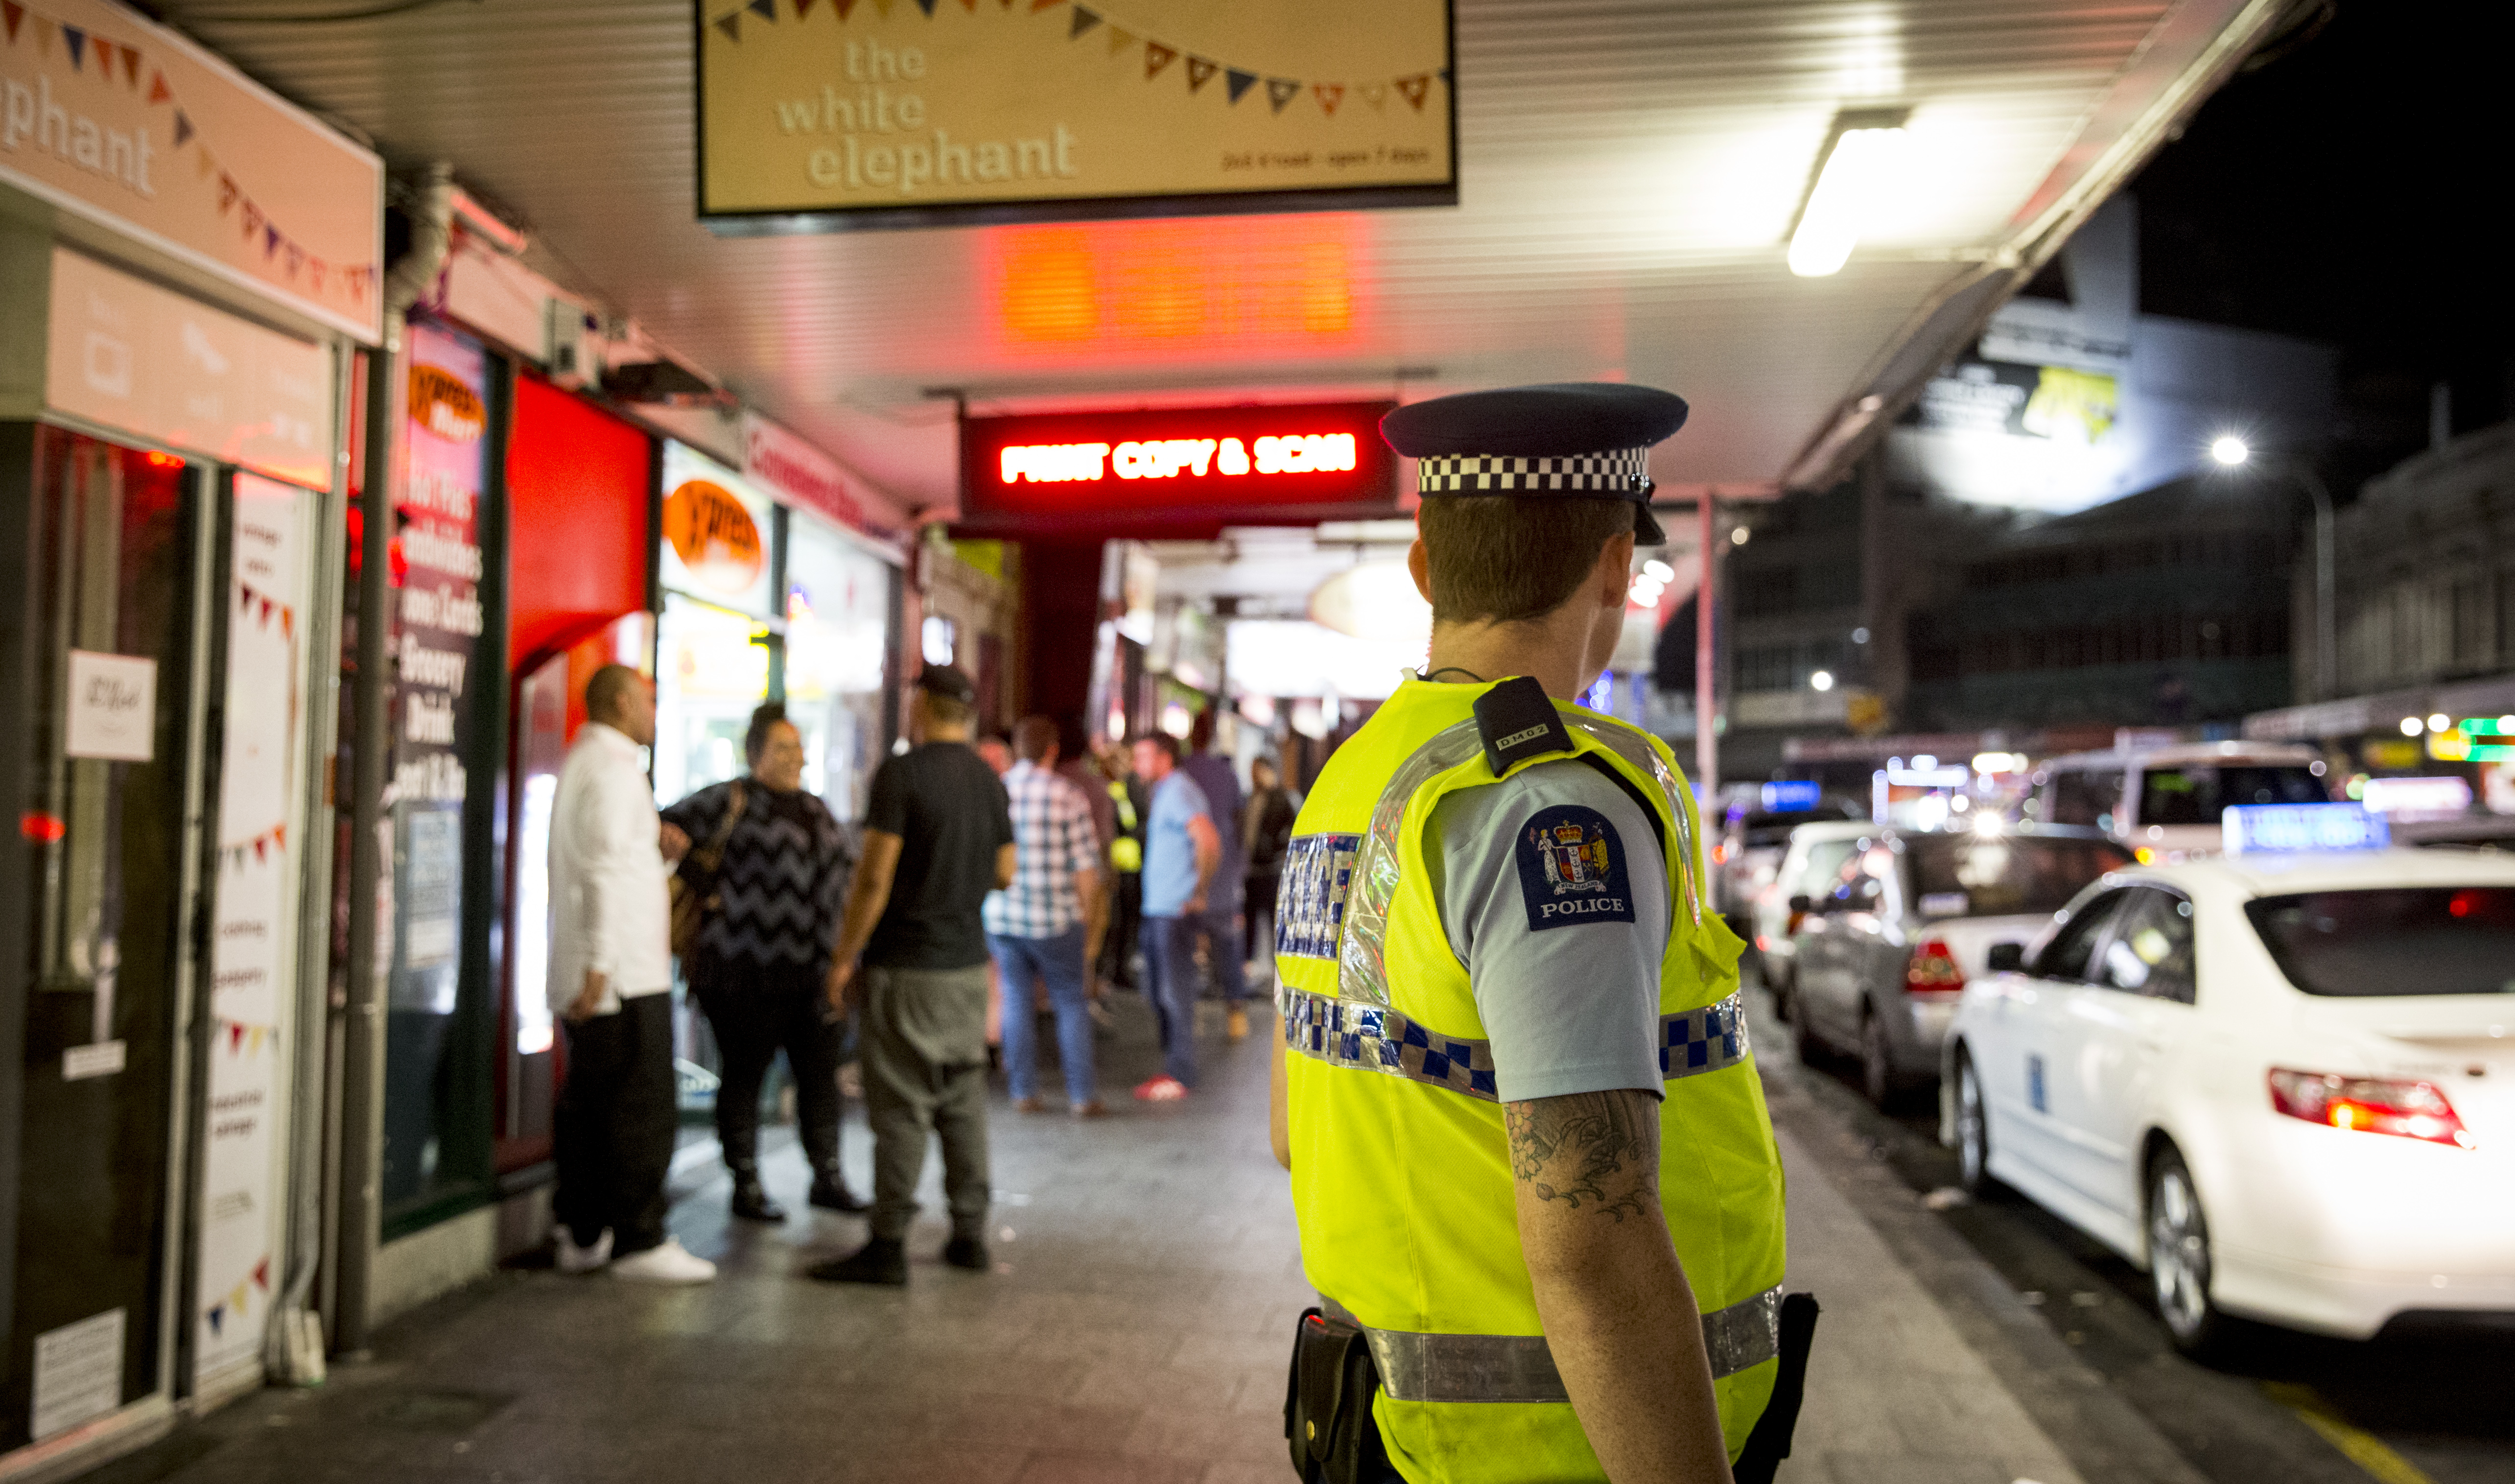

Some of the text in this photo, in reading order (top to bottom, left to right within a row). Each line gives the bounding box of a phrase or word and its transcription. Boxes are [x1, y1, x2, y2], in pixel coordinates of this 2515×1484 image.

[846, 37, 925, 80] the
[777, 85, 925, 132] white
[0, 72, 158, 195] phant
[808, 122, 1076, 193] elephant
[1113, 438, 1217, 479] COPY
[1218, 437, 1250, 475] &
[1253, 433, 1356, 474] SCAN
[1541, 898, 1624, 918] POLICE
[1575, 881, 1598, 889] ZEALAND
